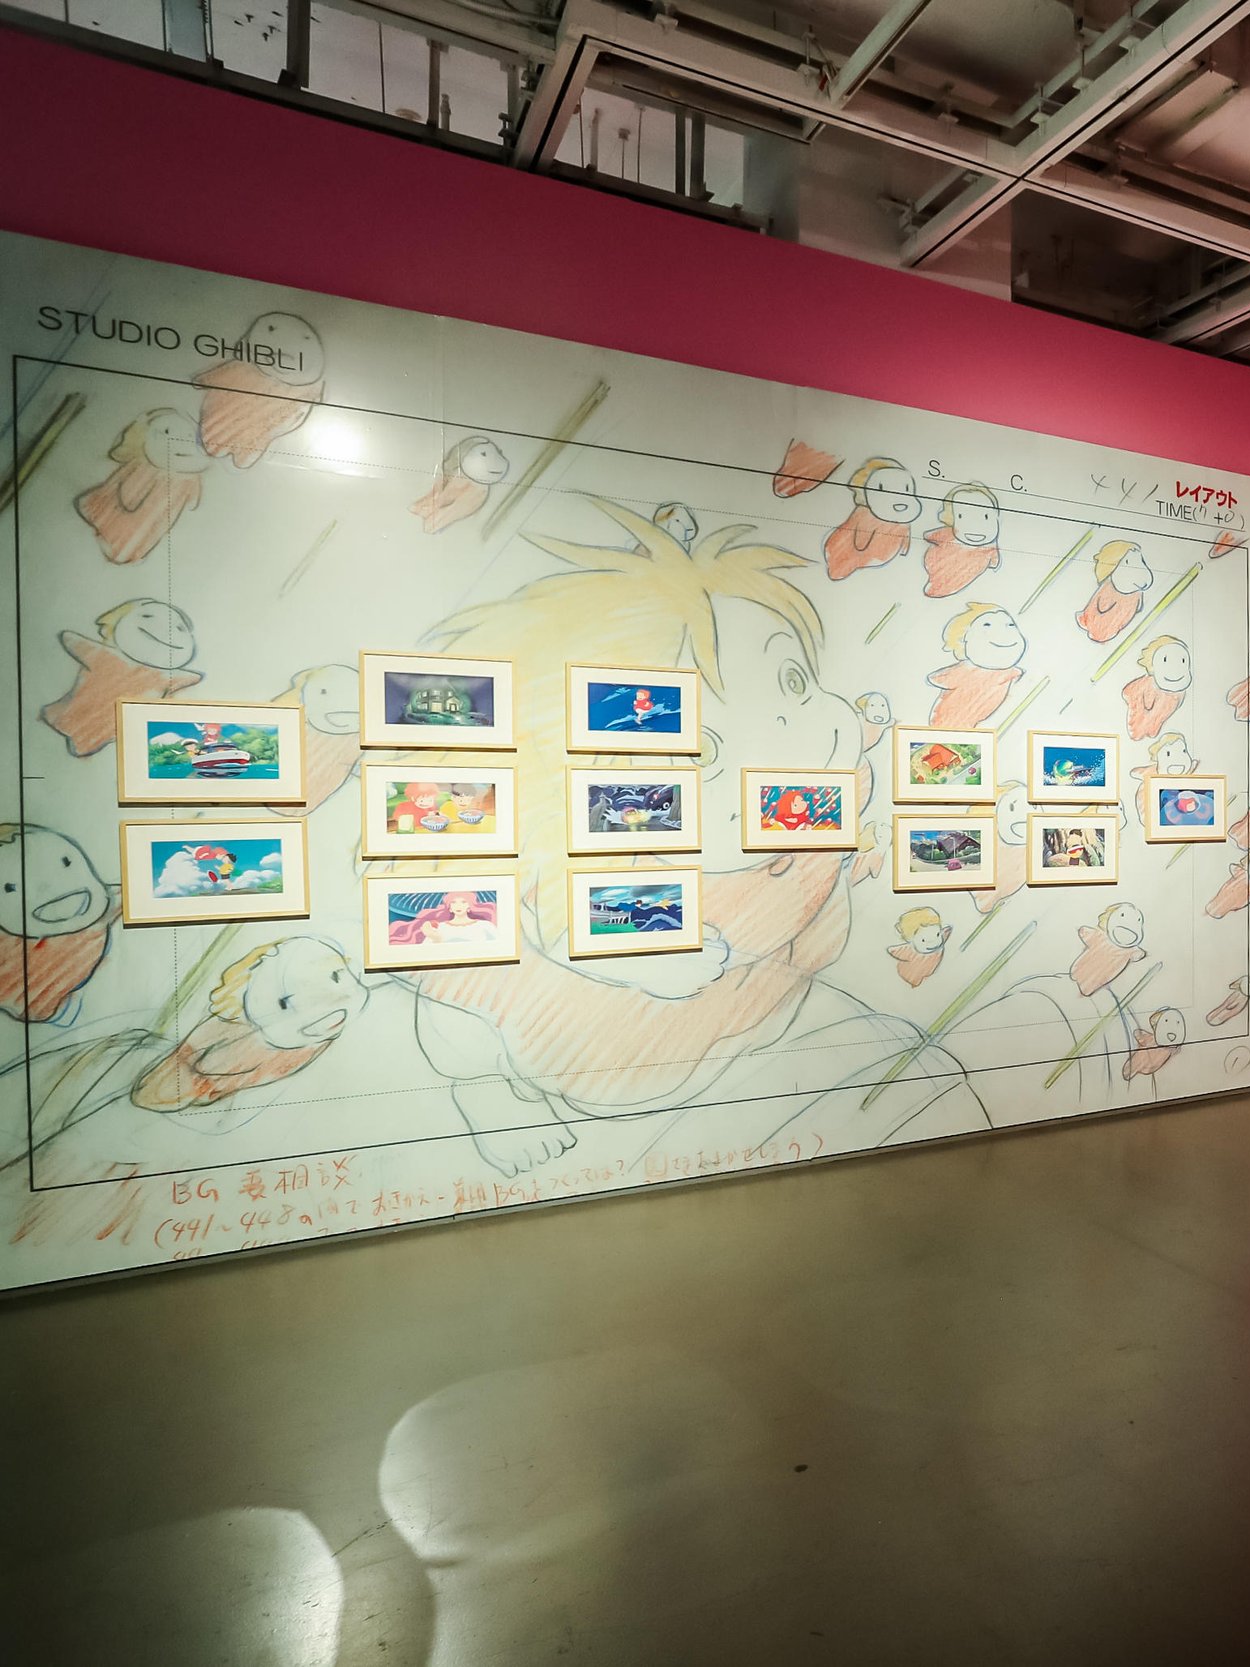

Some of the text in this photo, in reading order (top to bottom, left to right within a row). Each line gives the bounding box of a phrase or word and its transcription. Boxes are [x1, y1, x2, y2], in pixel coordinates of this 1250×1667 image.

[37, 305, 303, 372] STUDIO GHIBLI
[1175, 480, 1238, 509] レイアウト
